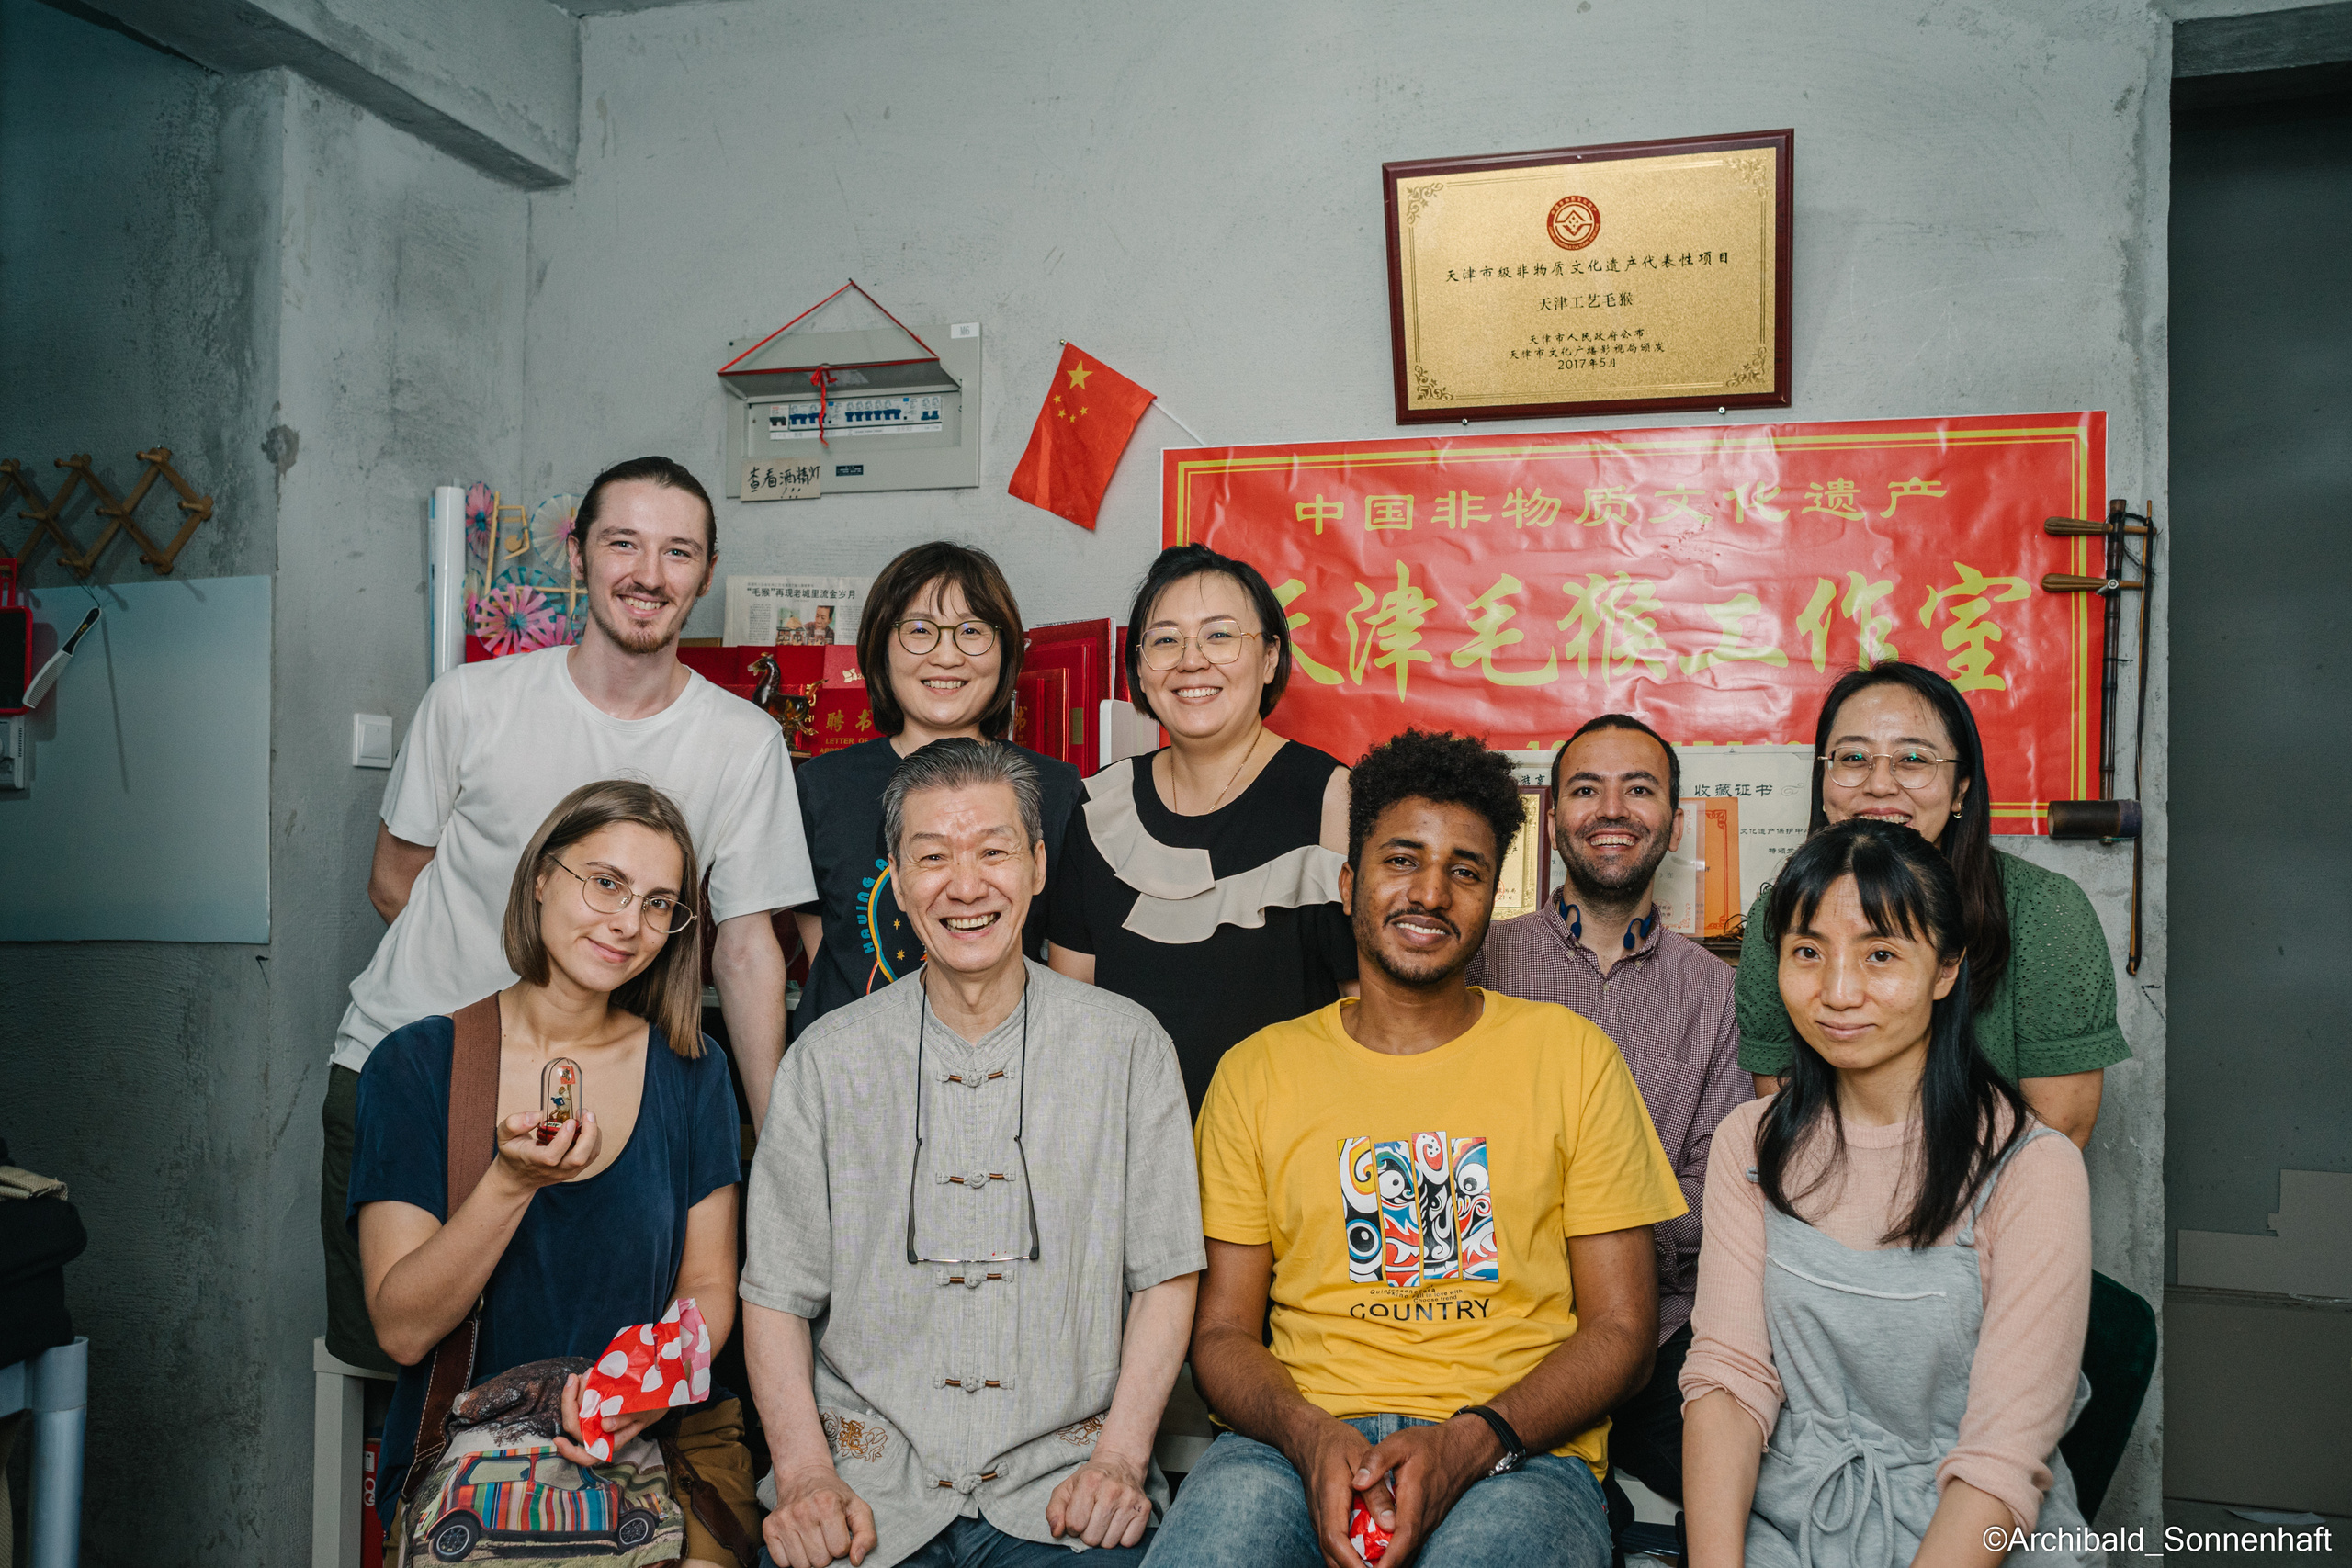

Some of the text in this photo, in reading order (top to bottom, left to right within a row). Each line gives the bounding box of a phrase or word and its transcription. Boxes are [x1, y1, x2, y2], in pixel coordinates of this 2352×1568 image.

[1537, 292, 1634, 311] 天津工艺毛猴
[1529, 328, 1645, 344] 天津市人民政府公布
[1509, 342, 1665, 360] 天津市文化广播影视局颁发
[1557, 357, 1616, 370] 2017年5月
[747, 466, 820, 492] 查看酒精灯
[1295, 476, 1948, 535] 中国非物质文化遗产
[1694, 784, 1773, 797] 收藏证书
[1350, 1298, 1490, 1321] COUNTRY
